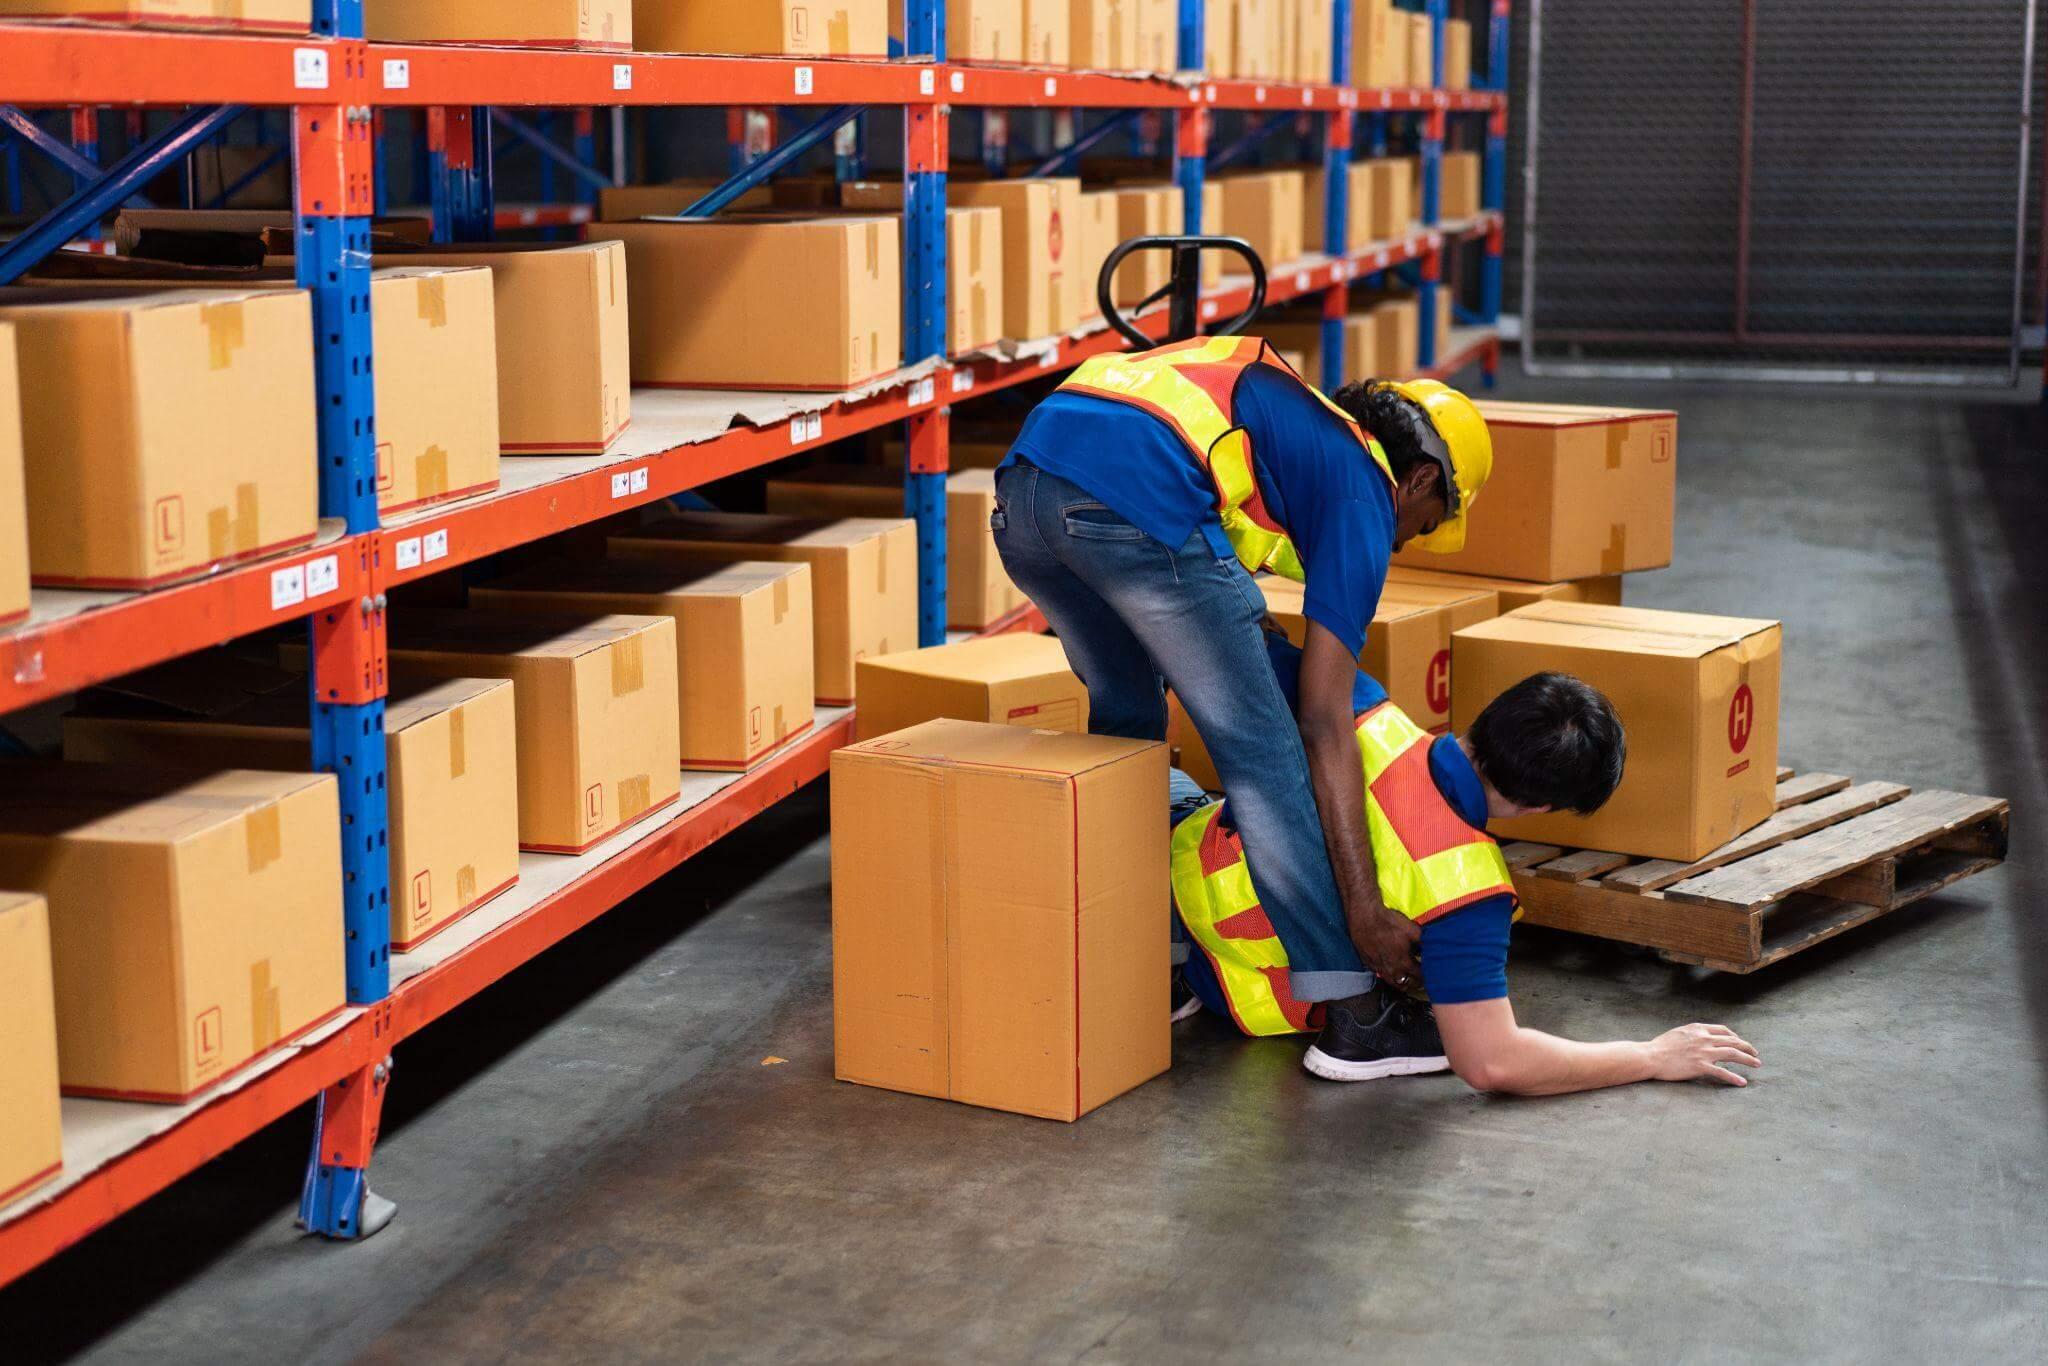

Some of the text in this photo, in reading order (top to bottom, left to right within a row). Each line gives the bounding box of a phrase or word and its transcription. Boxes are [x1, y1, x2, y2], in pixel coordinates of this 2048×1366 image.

[796, 12, 803, 35] L
[162, 506, 176, 540] L
[753, 713, 759, 736] L
[591, 792, 598, 818] L
[418, 881, 427, 910] L
[202, 1020, 217, 1052] L
